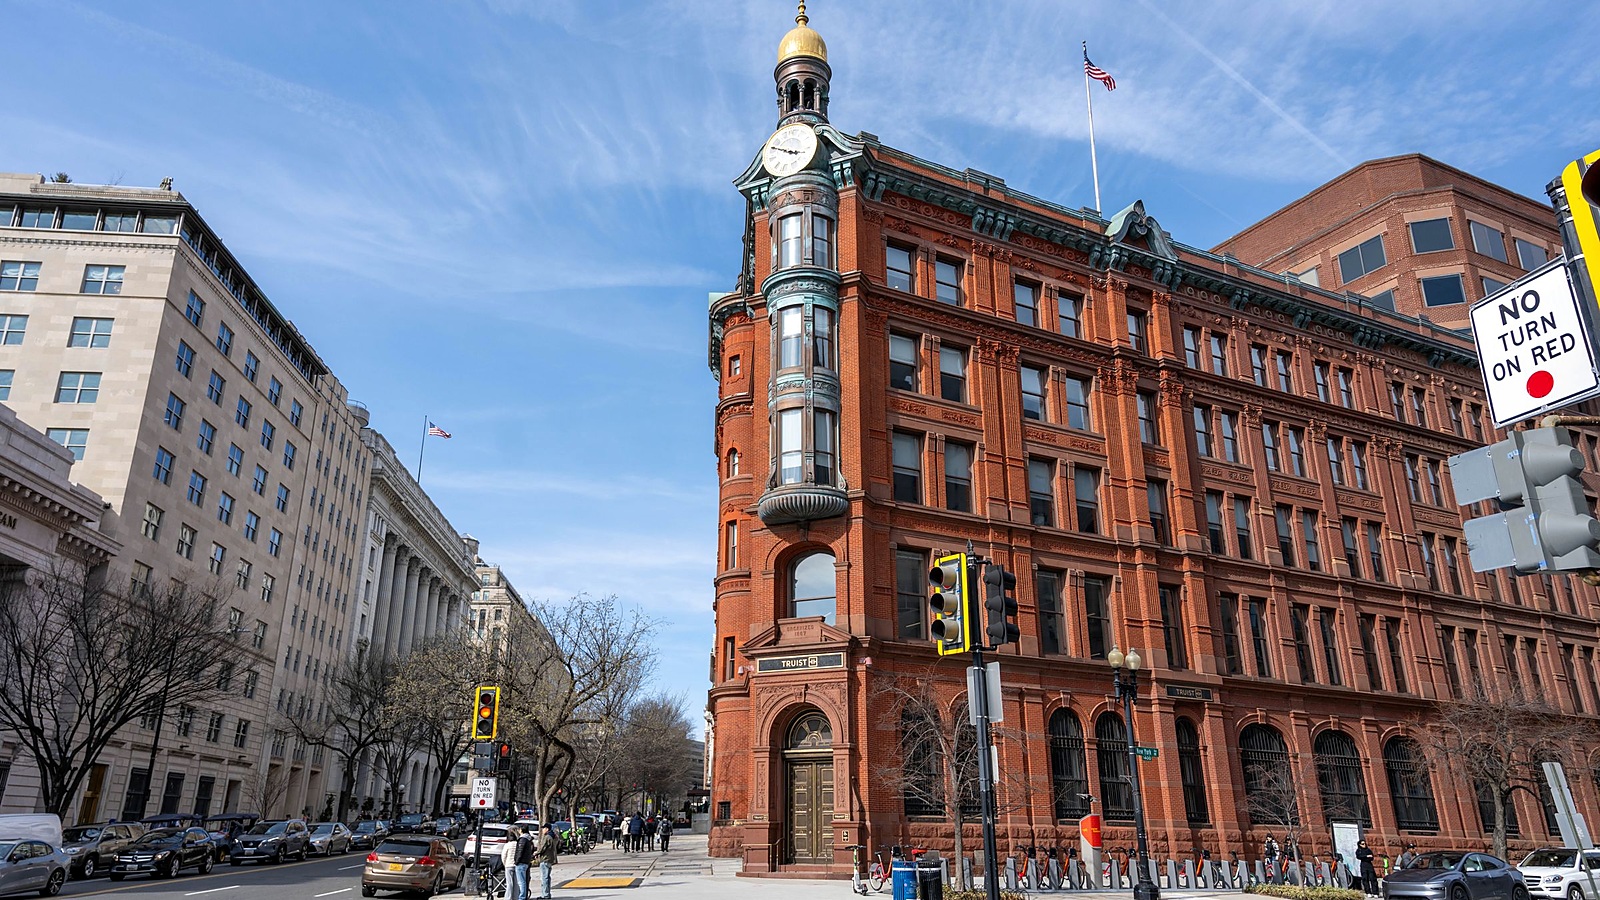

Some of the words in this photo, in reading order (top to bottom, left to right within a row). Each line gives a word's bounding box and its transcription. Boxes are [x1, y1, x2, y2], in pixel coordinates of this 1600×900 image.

[1498, 290, 1540, 326] NO
[1498, 312, 1557, 351] TURN
[1493, 355, 1522, 381] ON
[1531, 332, 1575, 366] RED
[781, 658, 807, 667] TRUIST
